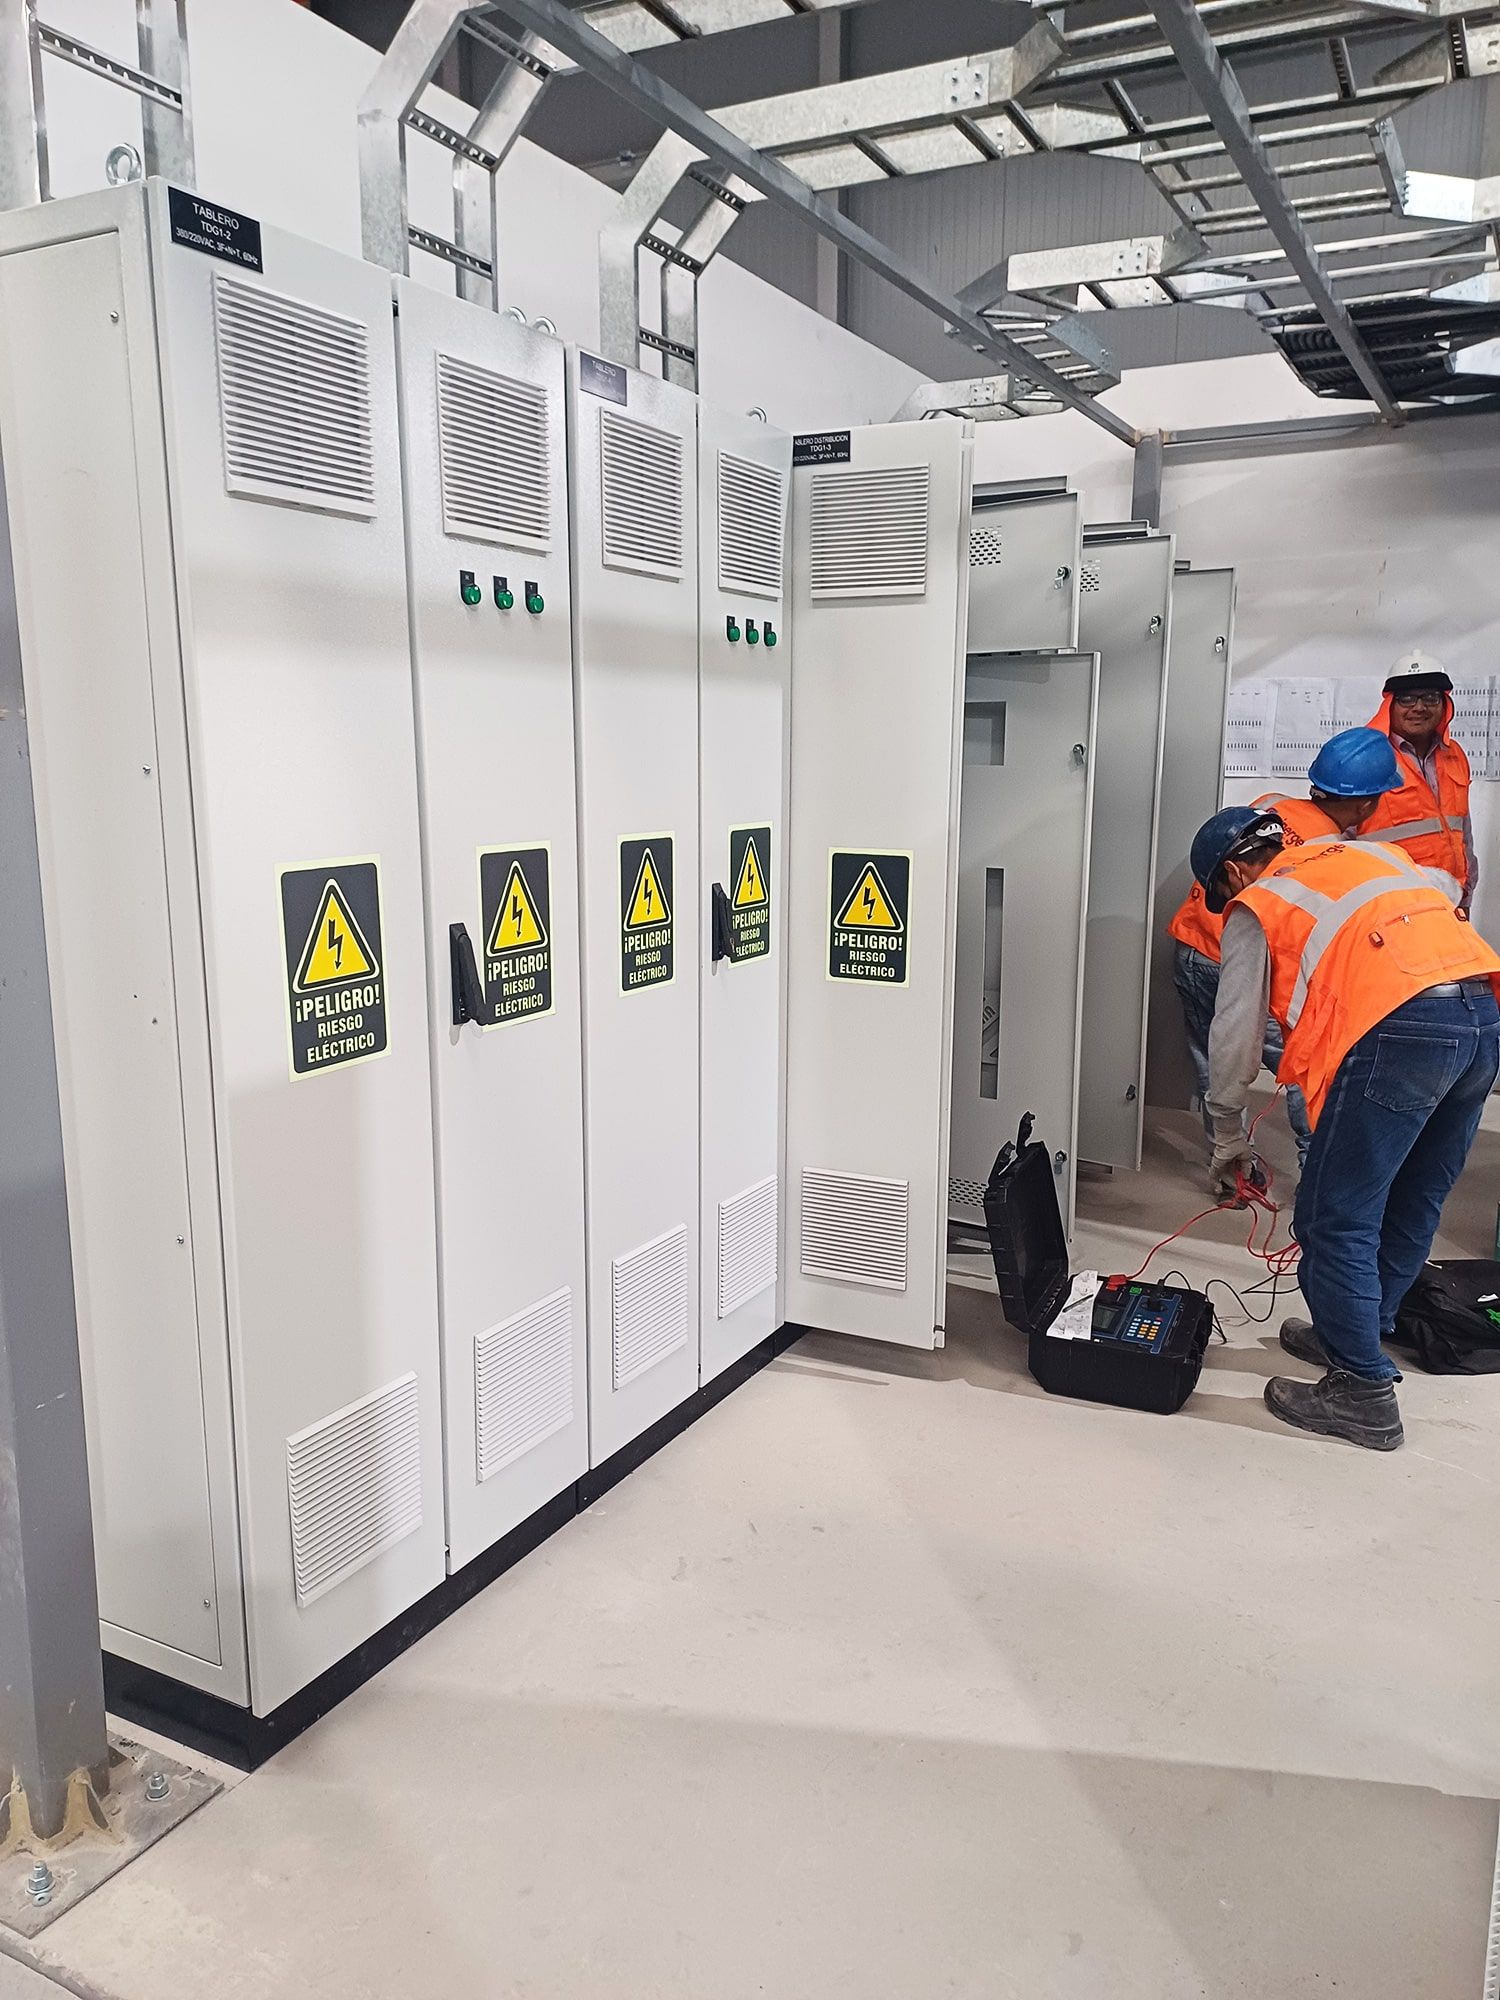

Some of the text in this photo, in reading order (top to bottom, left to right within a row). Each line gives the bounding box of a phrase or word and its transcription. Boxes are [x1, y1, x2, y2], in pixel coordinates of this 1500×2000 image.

[192, 202, 240, 230] TABLERO
[200, 220, 231, 241] TDG1-2
[732, 908, 768, 930] ¡PELIGRO!
[624, 928, 671, 954] ¡PELIGRO!
[740, 927, 760, 942] RIESGO
[834, 932, 903, 951] ¡PELIGRO!
[488, 951, 548, 982] ¡PELIGRO!
[635, 950, 661, 967] RIESGO
[849, 950, 886, 963] RIESGO
[629, 965, 667, 985] ELÉCTRICO
[839, 961, 895, 978] ELÉCTRICO
[503, 977, 535, 997] RIESGO
[295, 983, 380, 1023] ¡PELIGRO!
[495, 993, 543, 1017] ELÉCTRICO
[317, 1014, 363, 1039] RIESGO
[307, 1032, 375, 1063] ELÉCTRICO
